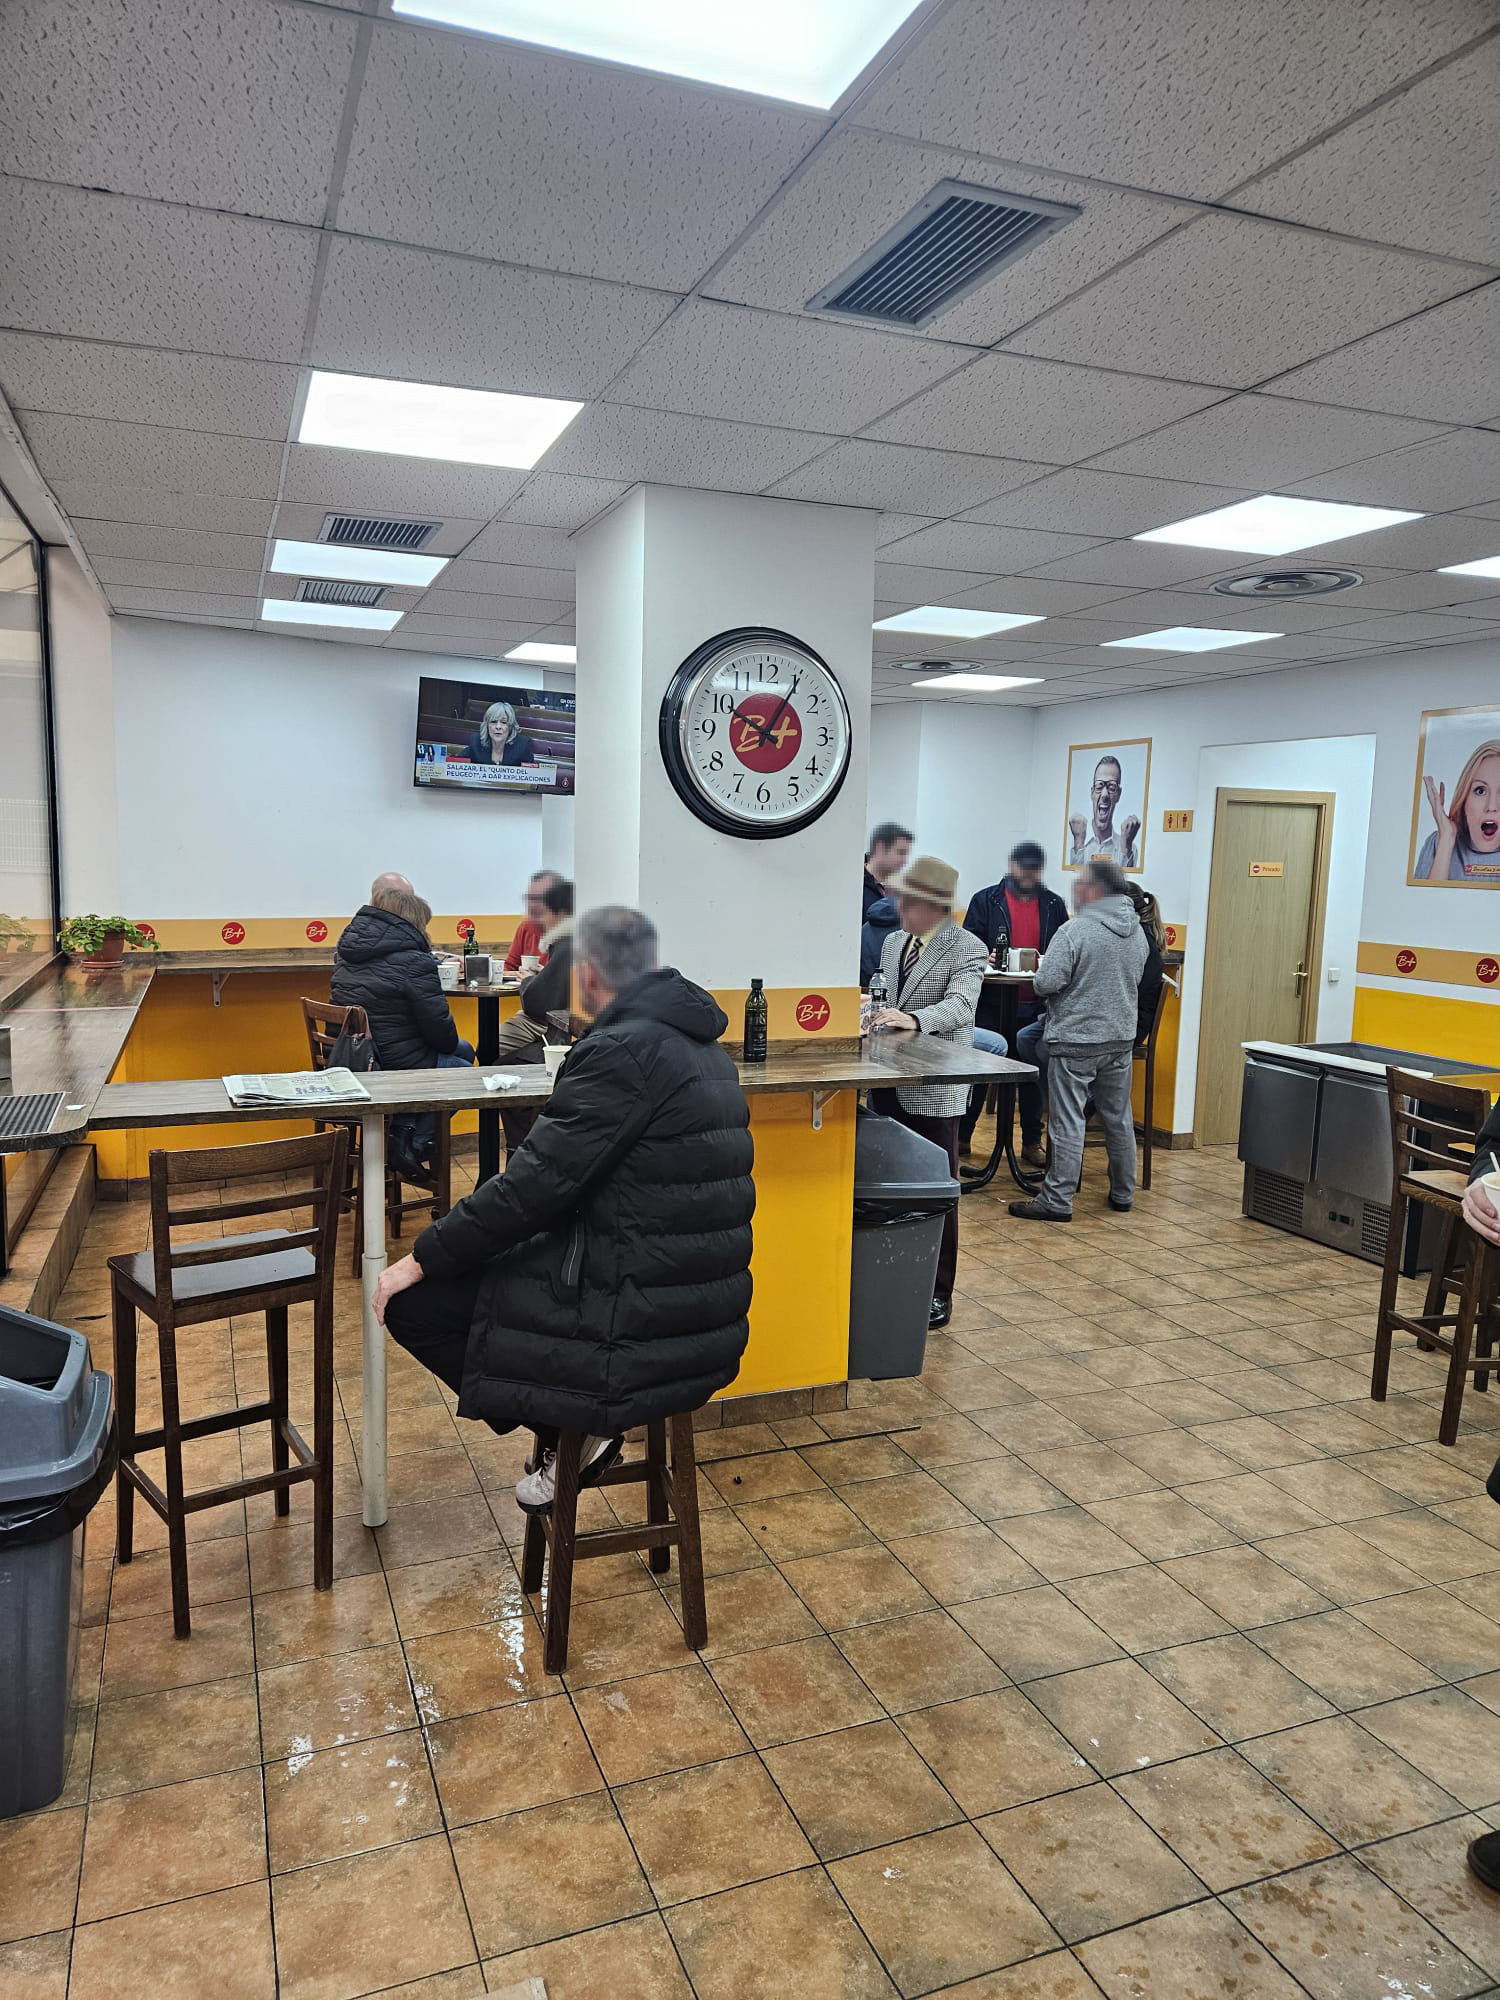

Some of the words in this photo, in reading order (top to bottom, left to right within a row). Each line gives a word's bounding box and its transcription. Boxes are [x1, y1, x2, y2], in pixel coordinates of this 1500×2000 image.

[733, 671, 750, 691] 11
[756, 662, 779, 684] 12
[711, 693, 734, 714] 10
[806, 694, 819, 714] 2
[701, 718, 717, 741] 9
[816, 726, 829, 747] 3
[709, 750, 724, 772] 8
[804, 754, 819, 775] 4
[503, 774, 551, 783] EXPLICACIONES
[732, 773, 745, 794] 7
[787, 776, 800, 797] 5
[756, 780, 771, 803] 6
[222, 927, 244, 939] B+
[307, 926, 327, 938] B+
[1397, 955, 1417, 967] B+
[1477, 964, 1498, 976] B+
[797, 1004, 829, 1022] B+
